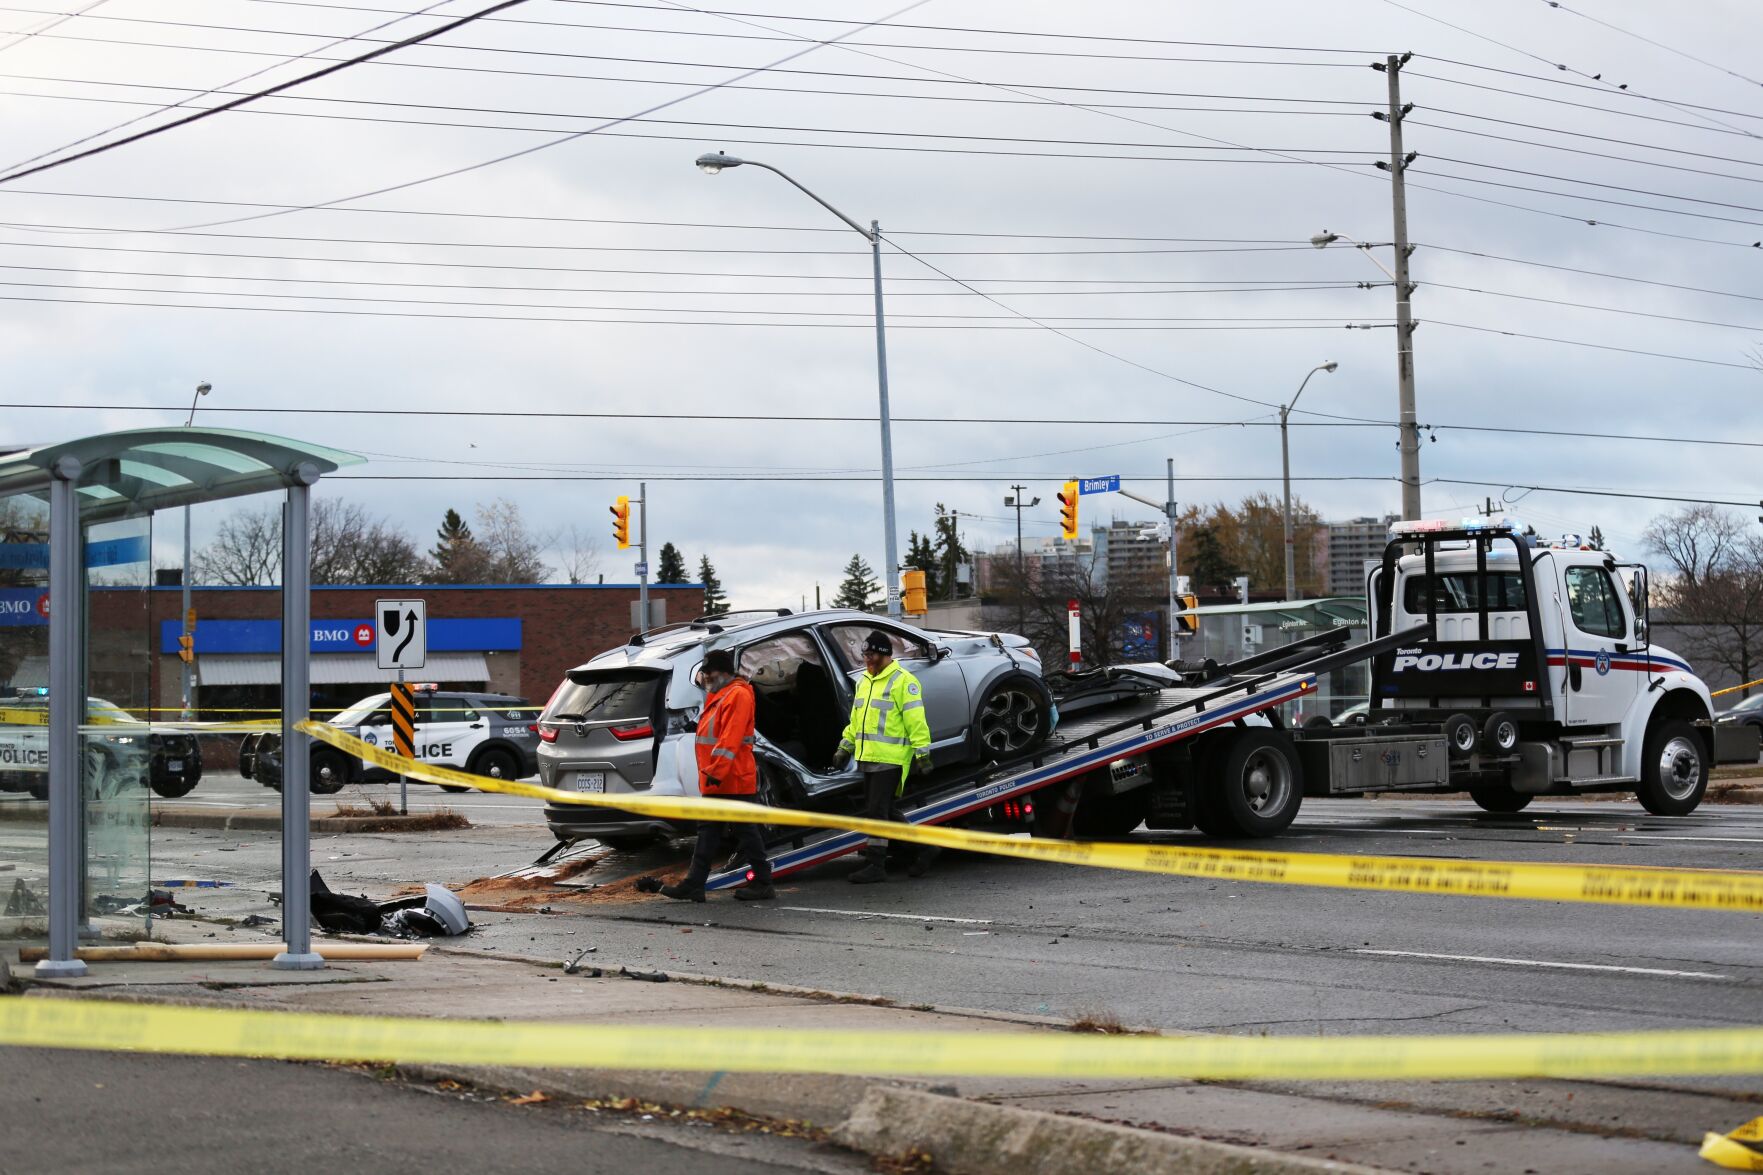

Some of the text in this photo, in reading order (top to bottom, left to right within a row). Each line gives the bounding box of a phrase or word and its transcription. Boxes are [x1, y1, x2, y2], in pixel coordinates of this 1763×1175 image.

[1084, 479, 1110, 492] Brimley
[313, 629, 349, 642] BMO
[1396, 647, 1422, 656] Toronto
[1392, 652, 1520, 672] POLICE
[1154, 729, 1171, 738] SERVE
[1176, 717, 1201, 731] PROTECT
[0, 749, 49, 764] OLICE
[384, 743, 453, 760] PLICE
[976, 780, 1016, 799] TORONTO POLICE
